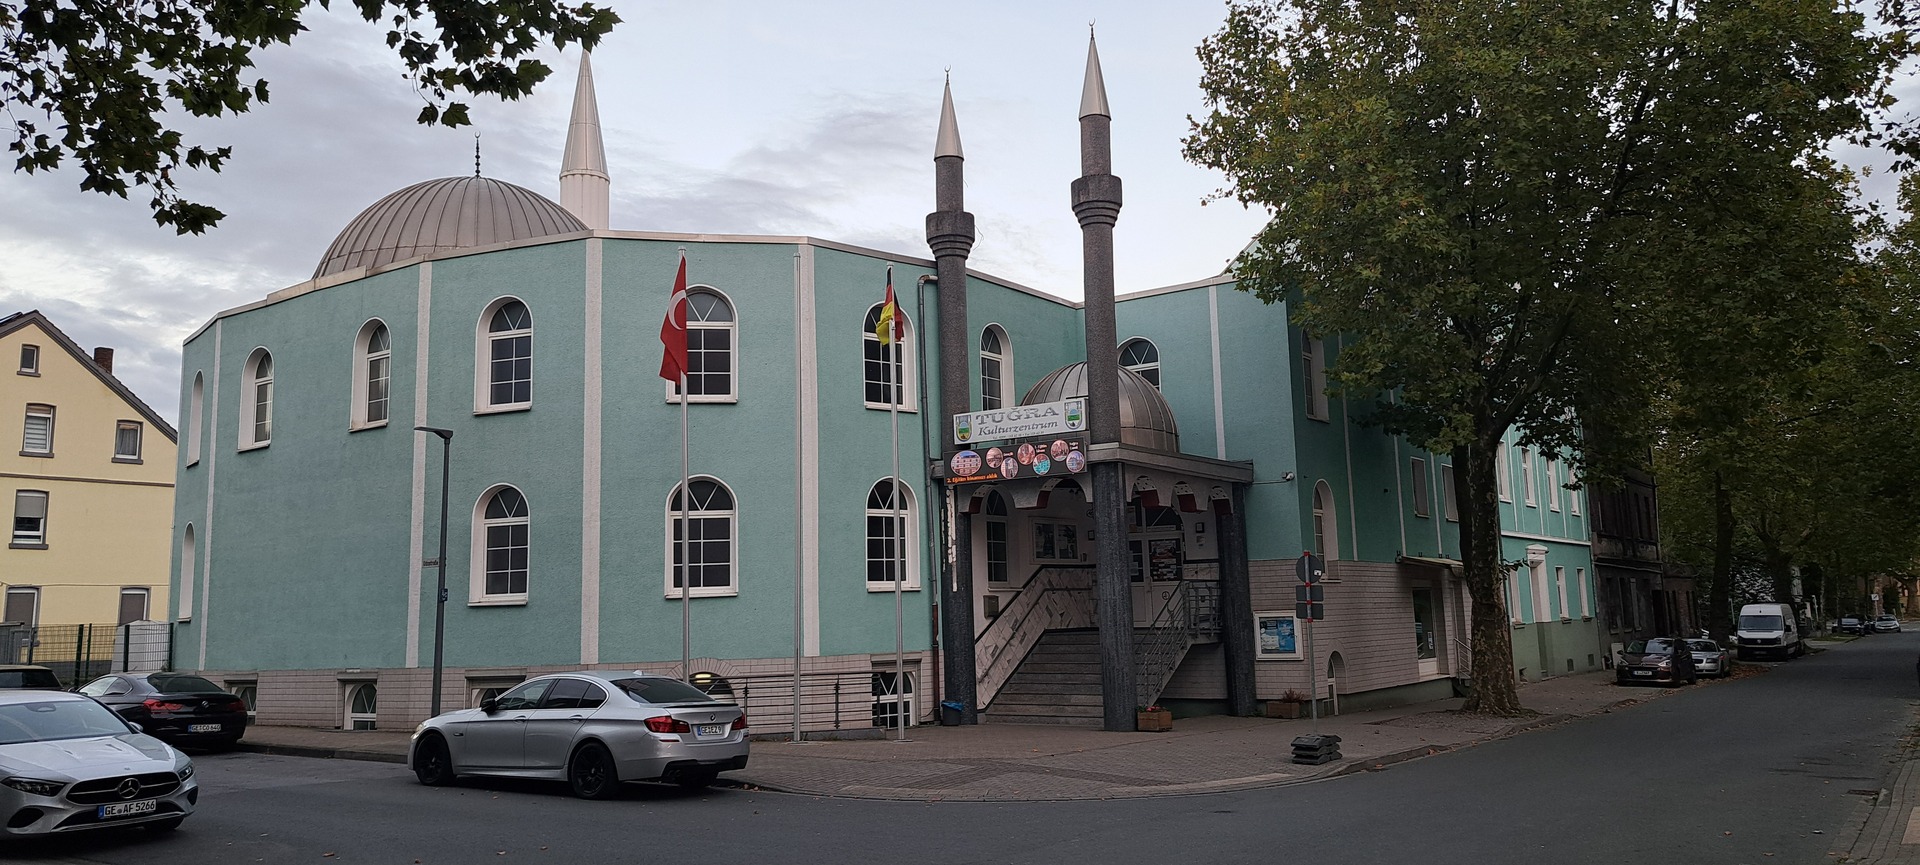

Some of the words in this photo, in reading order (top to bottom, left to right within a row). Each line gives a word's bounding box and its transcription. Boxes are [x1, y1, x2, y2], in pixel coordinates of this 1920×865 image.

[975, 407, 1060, 426] TUĞRA
[978, 421, 1059, 437] Kulturzentrum
[105, 805, 117, 815] GE
[123, 803, 134, 814] AF
[135, 800, 155, 812] 5266
